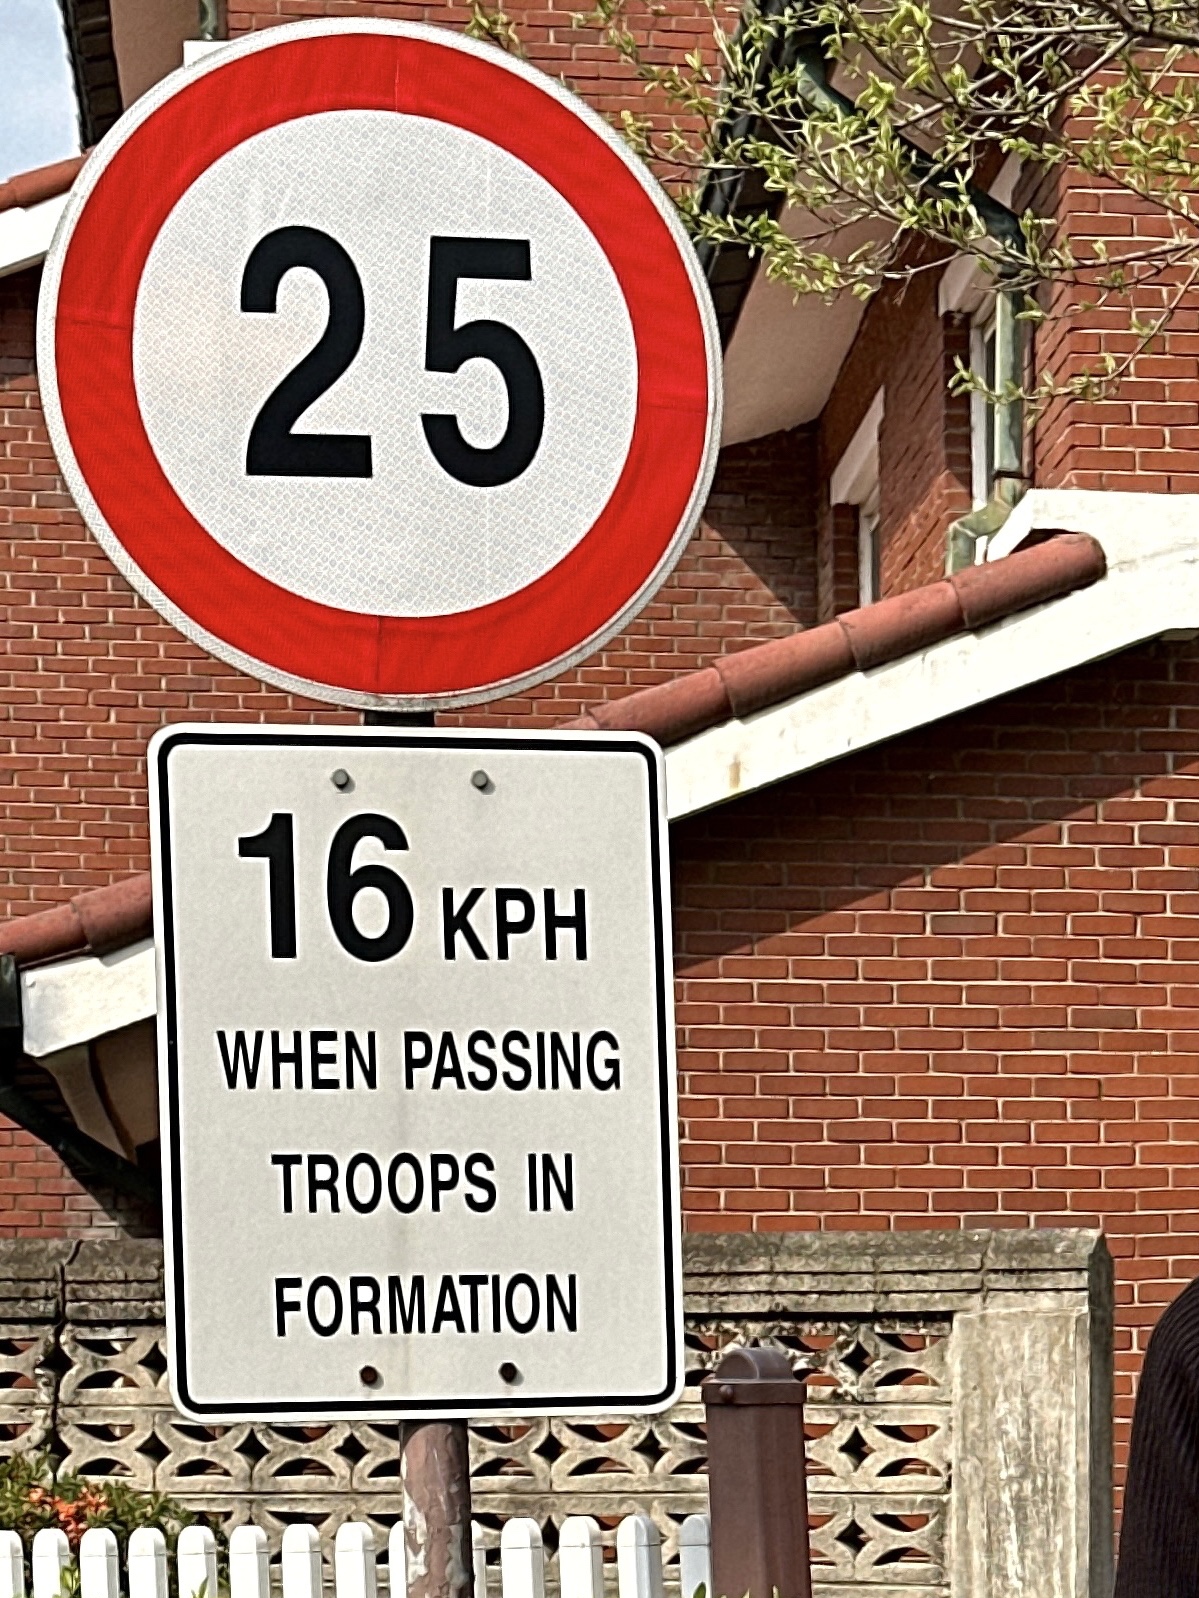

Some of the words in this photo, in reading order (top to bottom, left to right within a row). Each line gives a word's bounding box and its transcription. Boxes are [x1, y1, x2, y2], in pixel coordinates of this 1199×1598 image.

[240, 225, 546, 488] 25
[237, 812, 414, 963] 16
[442, 887, 588, 961] KPH
[216, 1030, 378, 1090] WHEN
[403, 1029, 621, 1092] PASSING
[270, 1152, 497, 1214] TROOPS
[527, 1152, 574, 1212] IN
[274, 1272, 577, 1338] FORMATION
